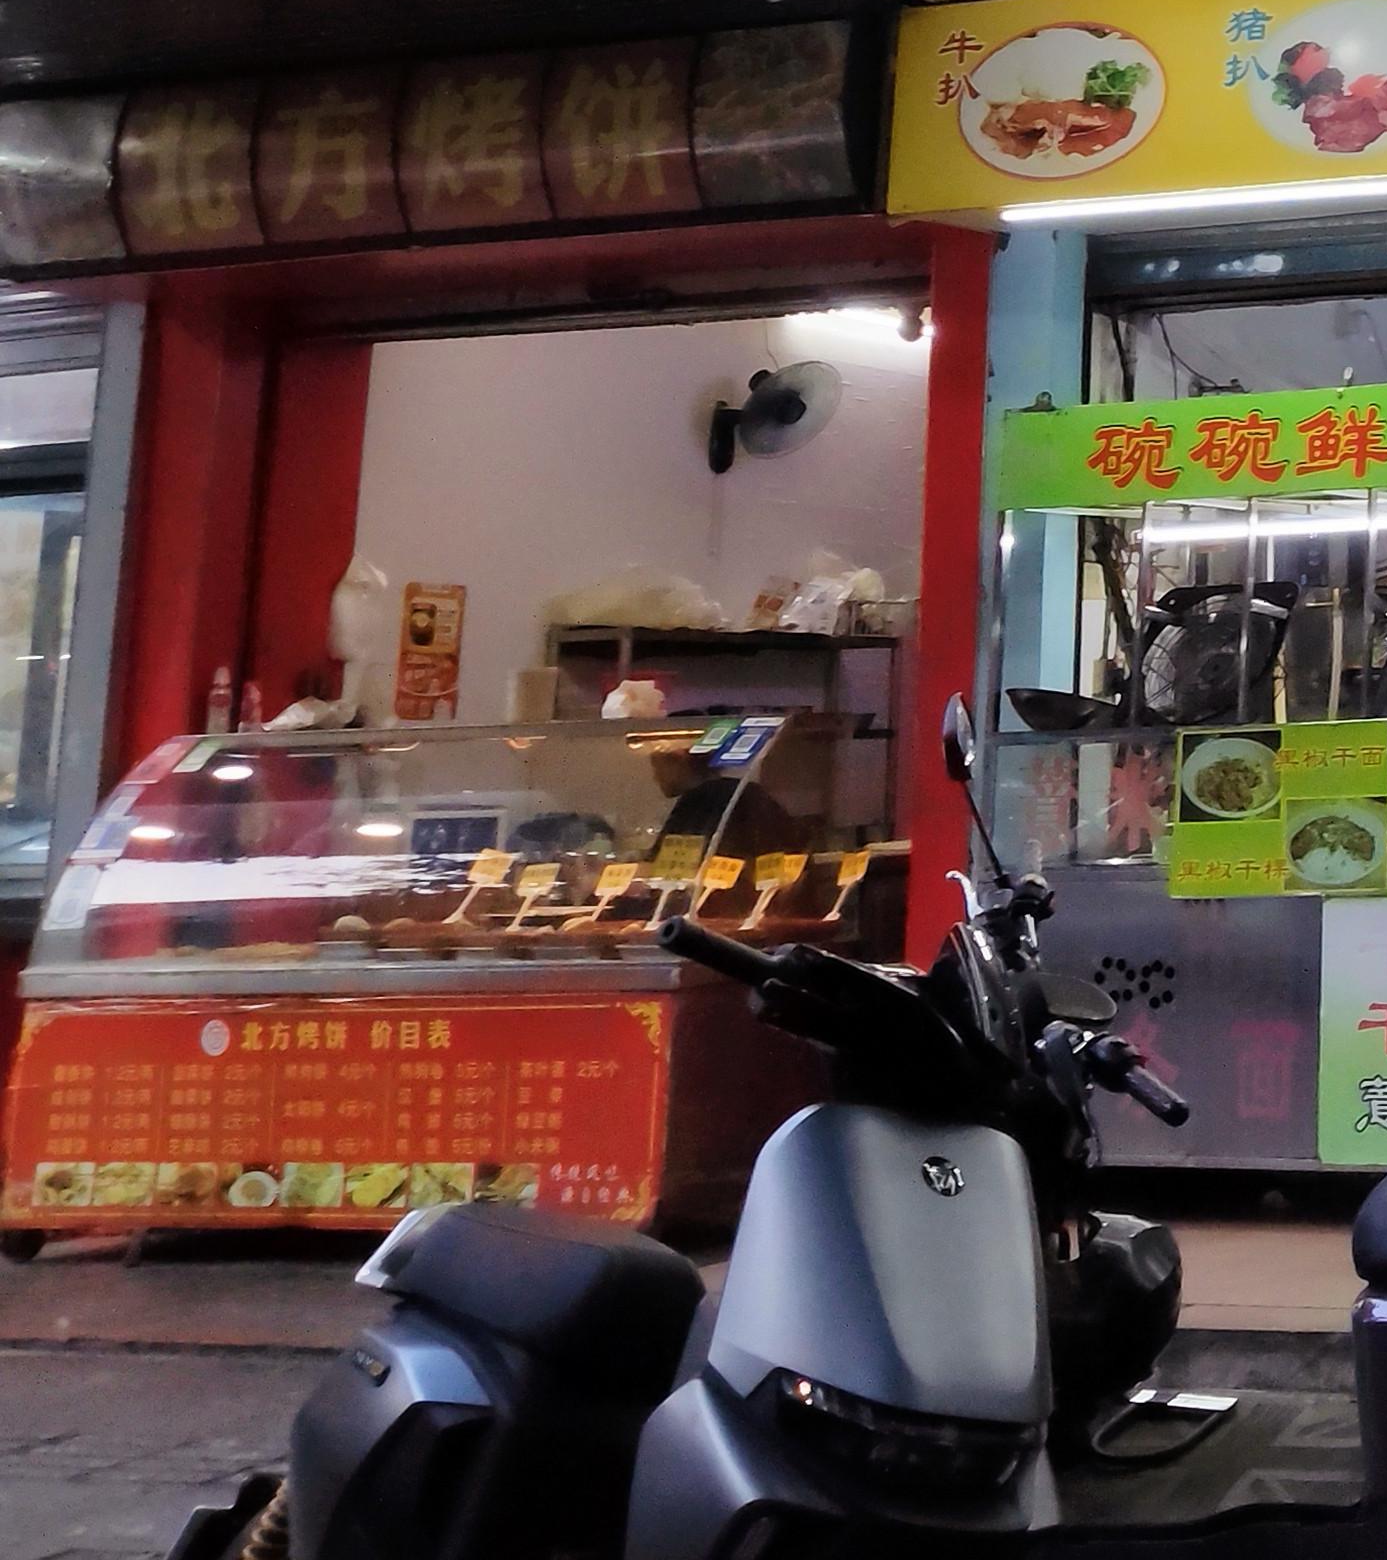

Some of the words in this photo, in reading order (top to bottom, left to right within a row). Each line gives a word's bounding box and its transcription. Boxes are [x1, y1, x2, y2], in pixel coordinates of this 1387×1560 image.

[935, 29, 984, 107] 牛扒
[1223, 8, 1274, 89] 猪扒
[121, 57, 674, 237] 北方烤饼
[1272, 744, 1387, 770] 黑椒干面
[1176, 857, 1291, 882] 黑椒干粿
[370, 1019, 452, 1050] 价目表
